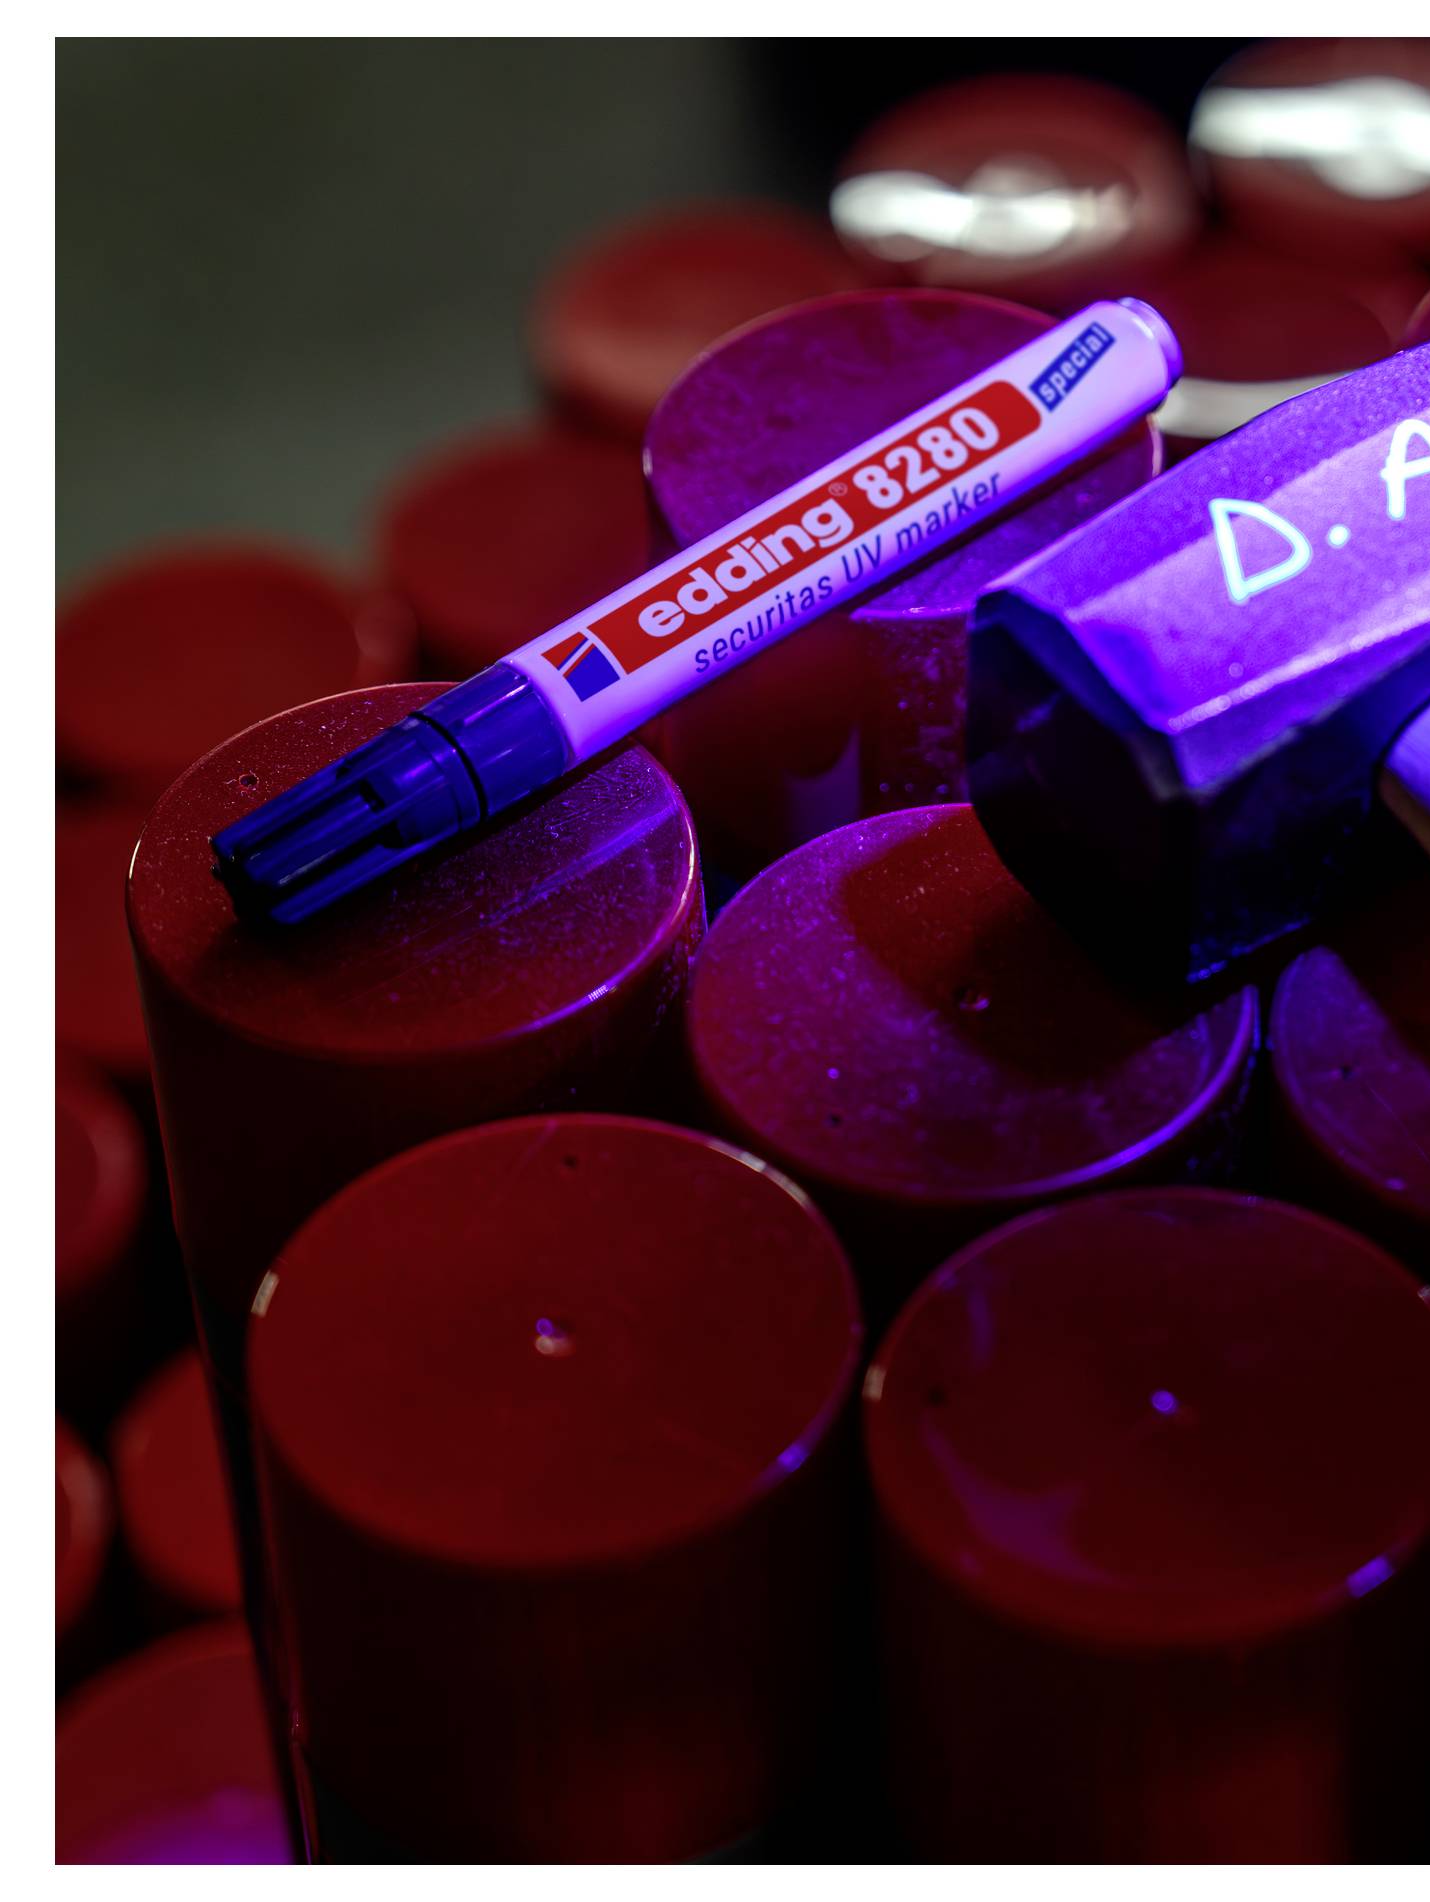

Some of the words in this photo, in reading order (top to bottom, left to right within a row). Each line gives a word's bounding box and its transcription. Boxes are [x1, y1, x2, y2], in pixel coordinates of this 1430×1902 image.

[1038, 325, 1110, 403] special
[638, 497, 855, 638] edding
[852, 407, 1000, 510] 8280
[694, 575, 834, 674] securitas
[841, 534, 882, 584] UV
[896, 472, 1000, 553] marker
